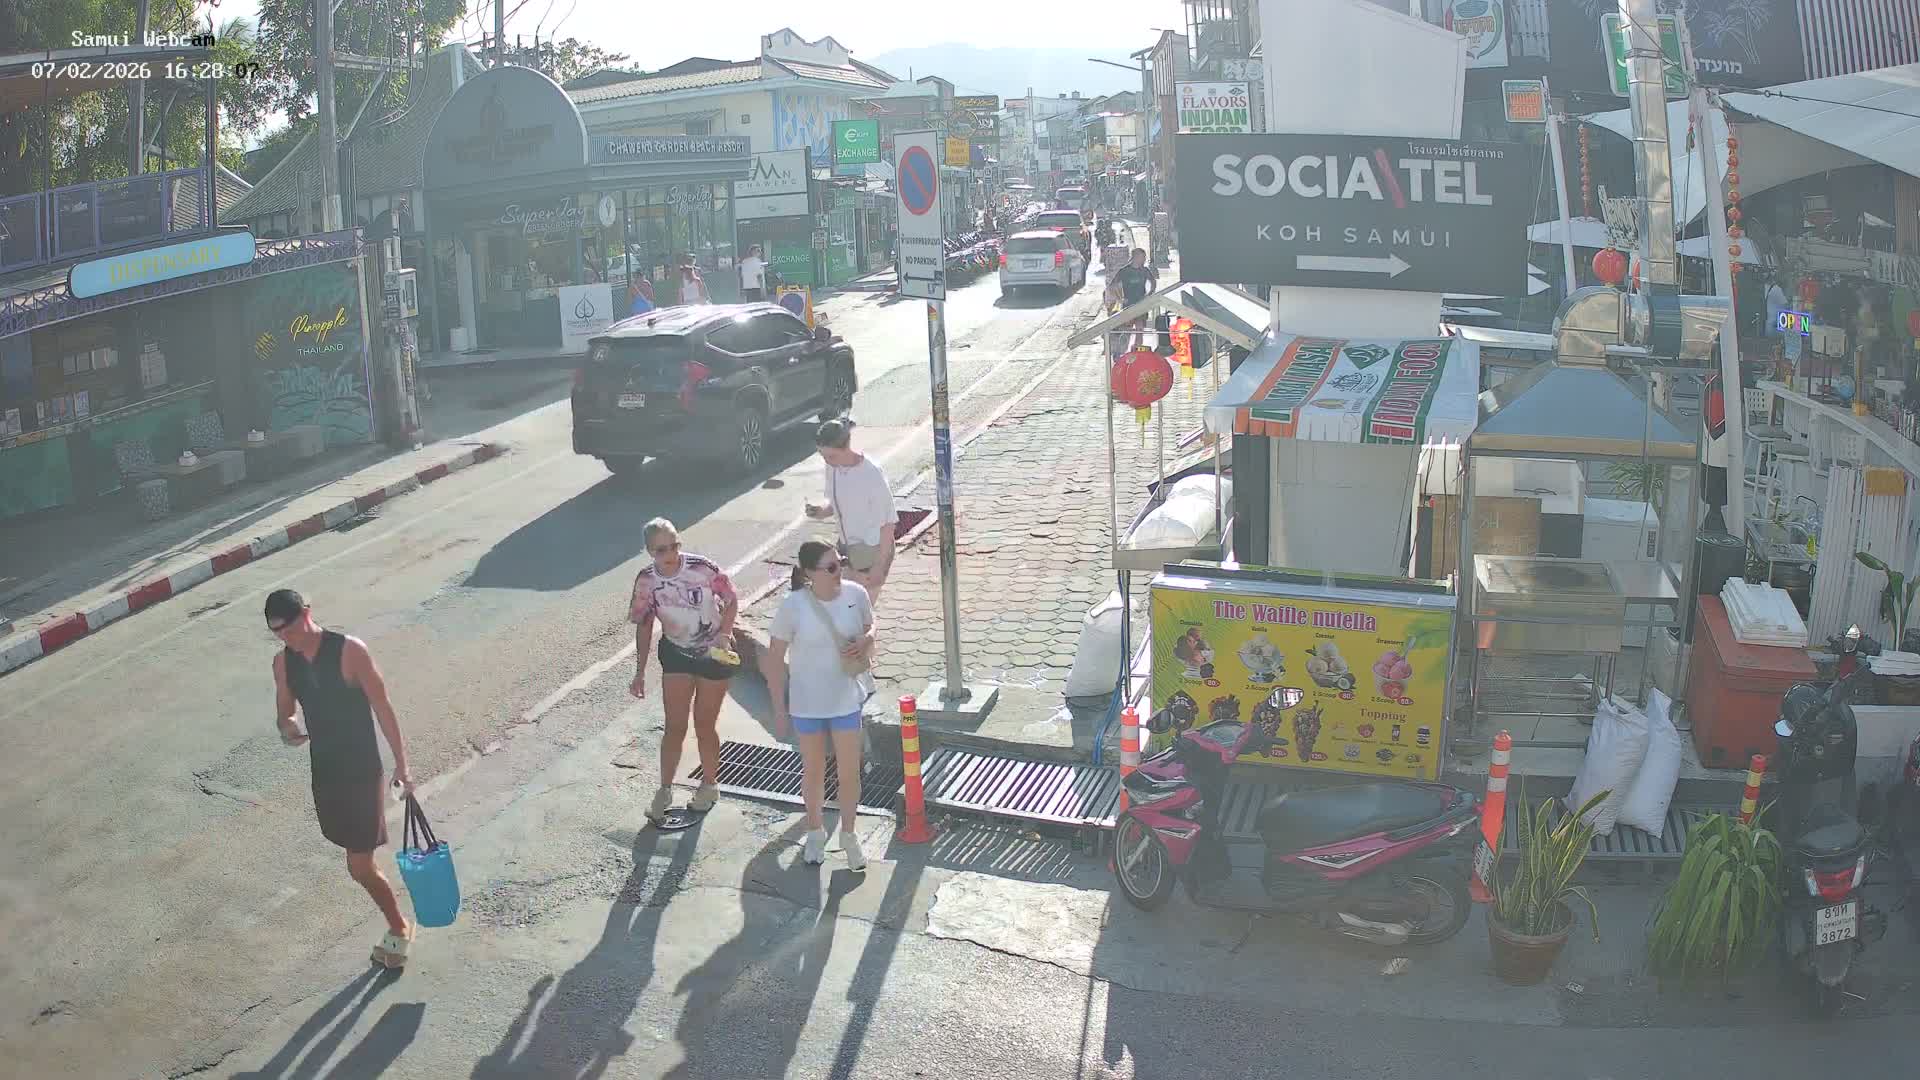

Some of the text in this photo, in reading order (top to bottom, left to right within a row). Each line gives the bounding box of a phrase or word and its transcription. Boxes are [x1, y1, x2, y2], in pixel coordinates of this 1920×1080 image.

[1182, 95, 1247, 109] FLAVORS
[1181, 108, 1248, 126] INDIAN
[609, 140, 745, 155] CHAWENG GARDEN BEACH RESORT
[837, 147, 878, 159] EXCHANGE
[1256, 224, 1451, 249] KOH SAMUI
[109, 243, 222, 283] DISPENSARY
[771, 254, 811, 265] EXCHANGE
[905, 255, 937, 266] NO PARKING
[290, 307, 348, 343] Pineapple
[1779, 312, 1810, 332] OPEN
[297, 343, 345, 356] THAILAND
[1213, 599, 1377, 633] The Waffle nutella
[1360, 708, 1408, 723] Topping
[1820, 927, 1851, 944] 3872
